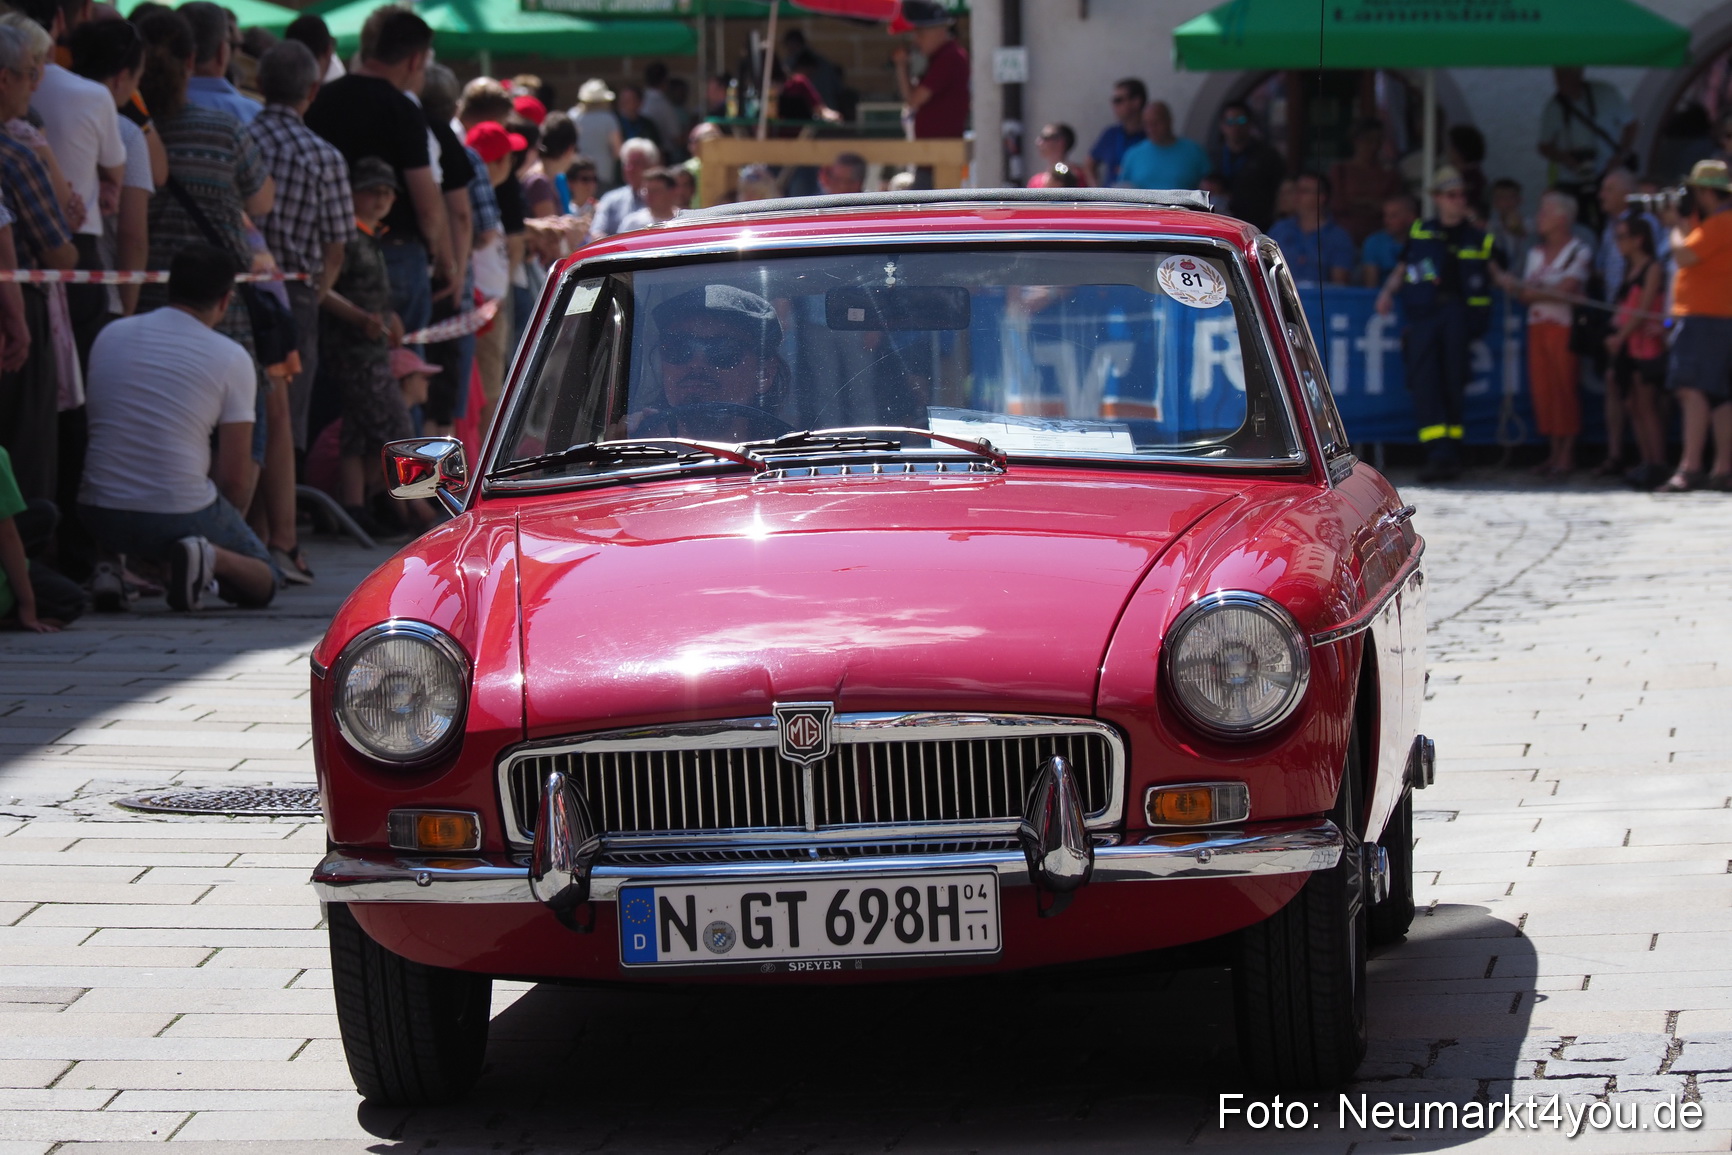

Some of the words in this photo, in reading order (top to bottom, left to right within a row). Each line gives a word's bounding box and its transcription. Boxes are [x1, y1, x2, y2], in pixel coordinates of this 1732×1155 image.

[1180, 272, 1203, 288] 81
[790, 717, 818, 746] MG
[963, 883, 988, 900] 04
[658, 894, 699, 953] N
[739, 889, 808, 949] GT
[824, 885, 961, 947] 698H
[966, 923, 989, 941] 11
[633, 933, 646, 950] D
[788, 960, 842, 972] SPEYER
